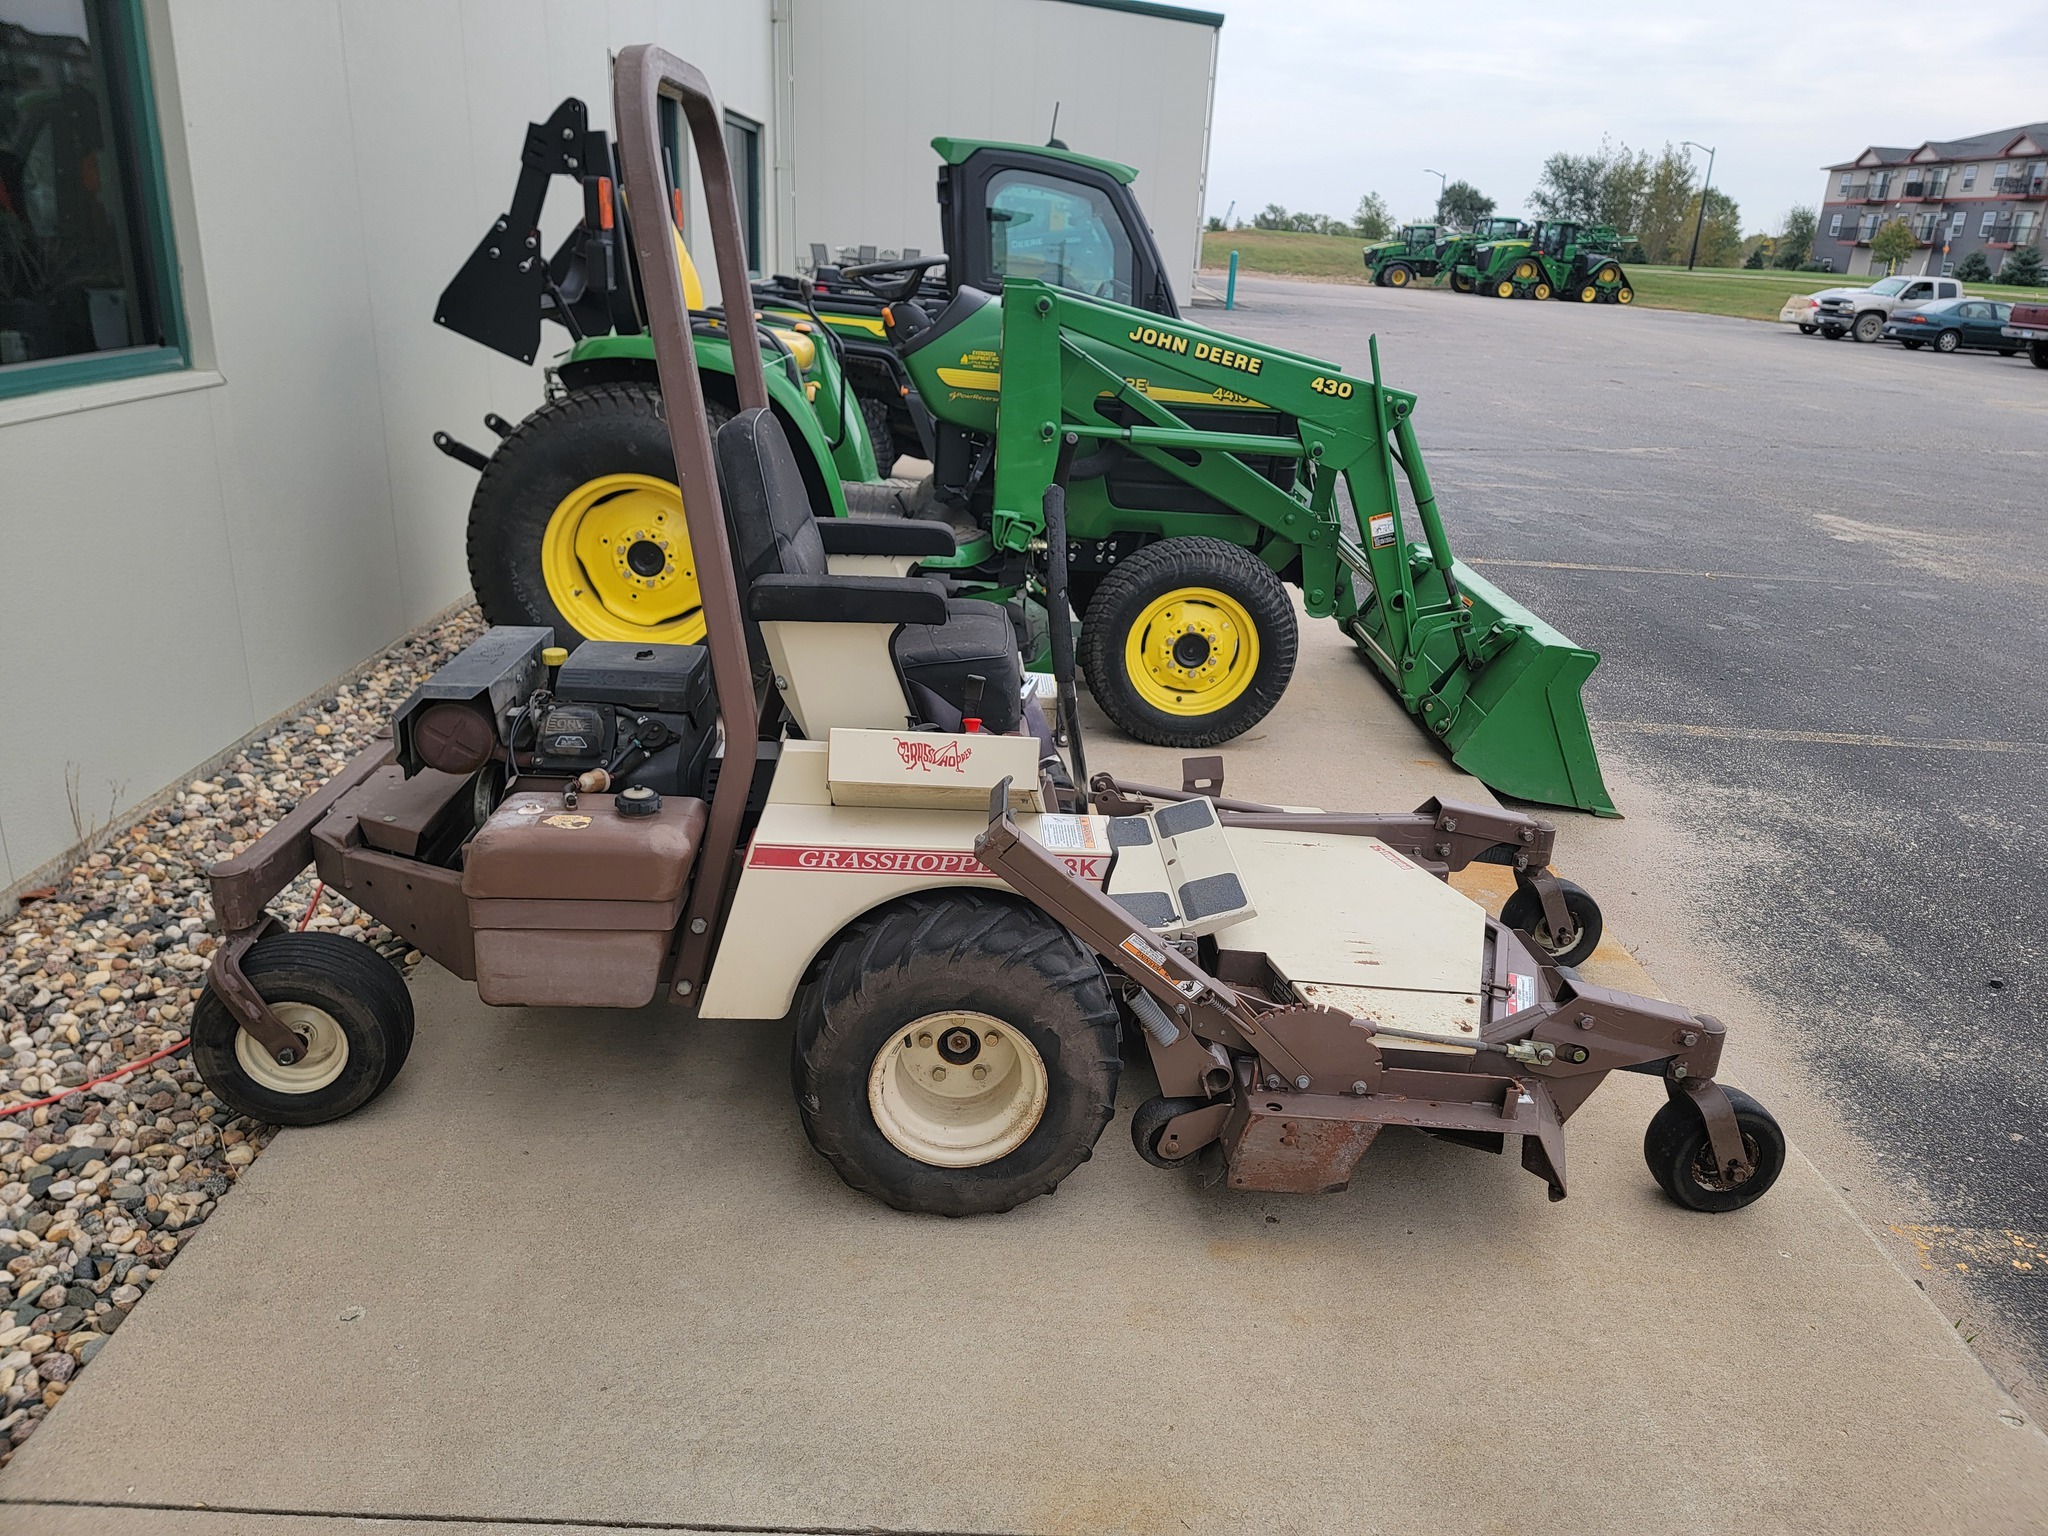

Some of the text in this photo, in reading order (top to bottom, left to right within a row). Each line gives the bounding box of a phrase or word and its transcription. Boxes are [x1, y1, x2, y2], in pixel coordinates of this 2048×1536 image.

[1128, 326, 1263, 376] JOHN DEERE
[956, 392, 999, 401] PowrReverse
[1311, 377, 1353, 399] 430
[798, 851, 992, 873] GRASSHOPP
[1063, 858, 1098, 878] 8K
